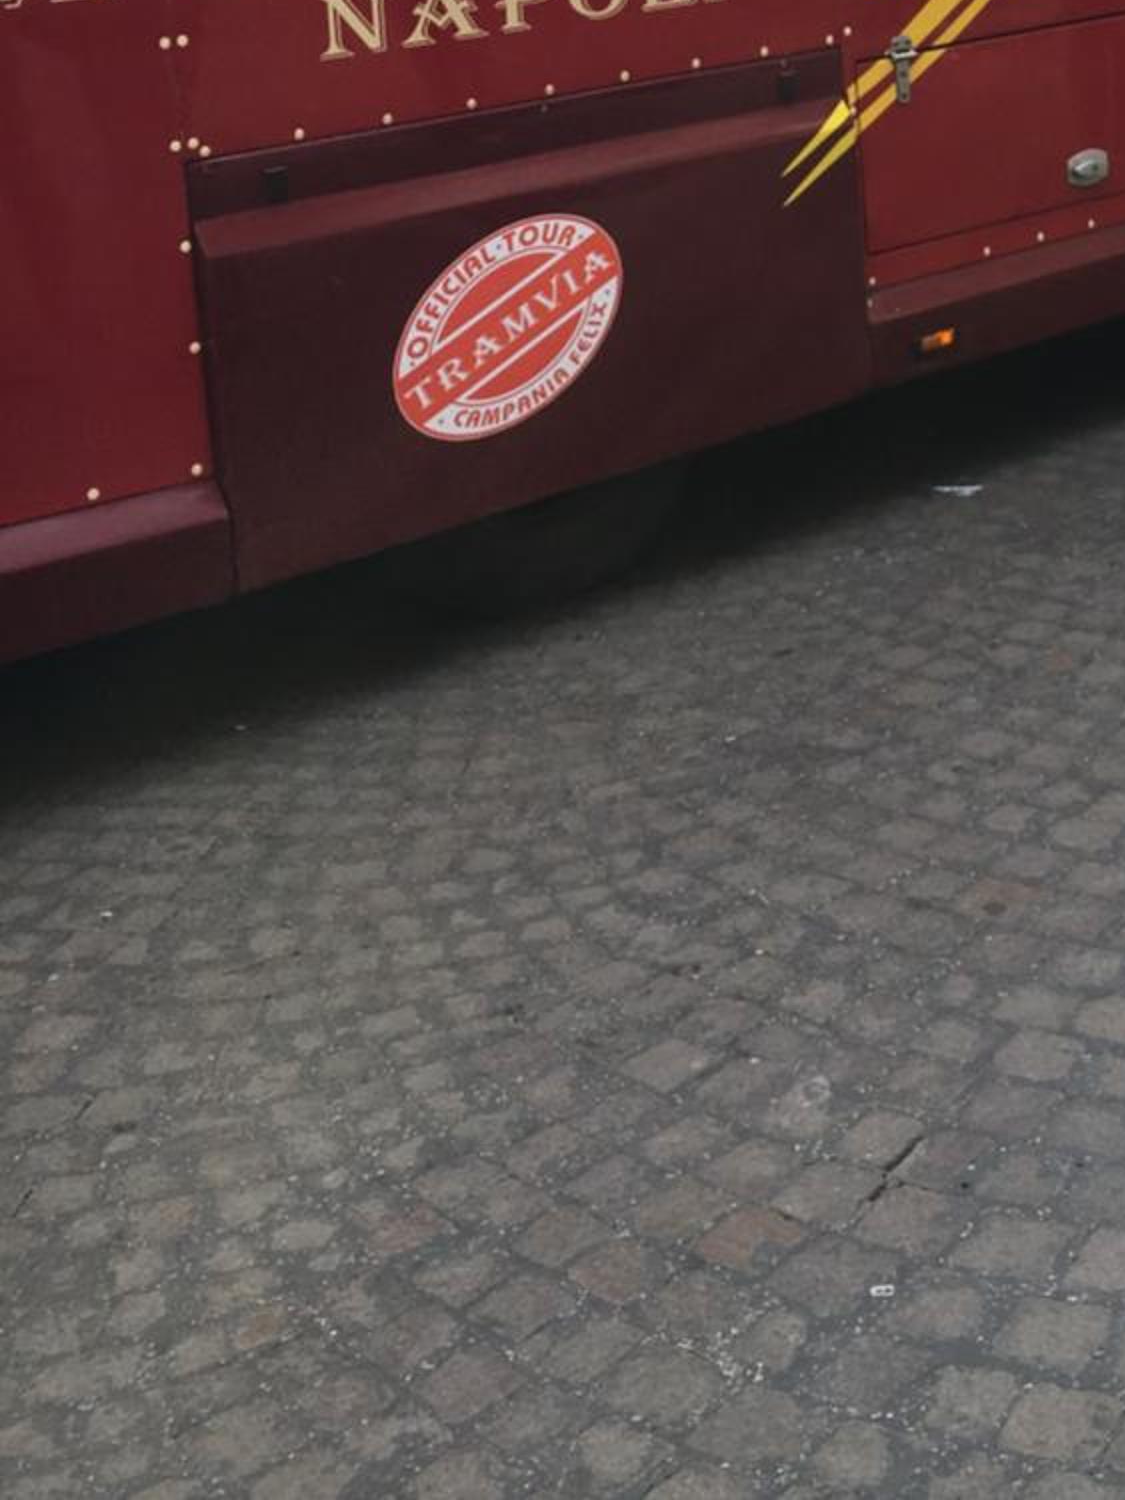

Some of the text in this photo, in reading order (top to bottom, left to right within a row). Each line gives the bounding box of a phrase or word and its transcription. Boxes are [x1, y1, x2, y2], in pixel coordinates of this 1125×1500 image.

[403, 250, 611, 409] TRAMVIA
[406, 223, 577, 359] OFFICIAL TOUR
[453, 301, 608, 428] CAMPANIA FELIX
